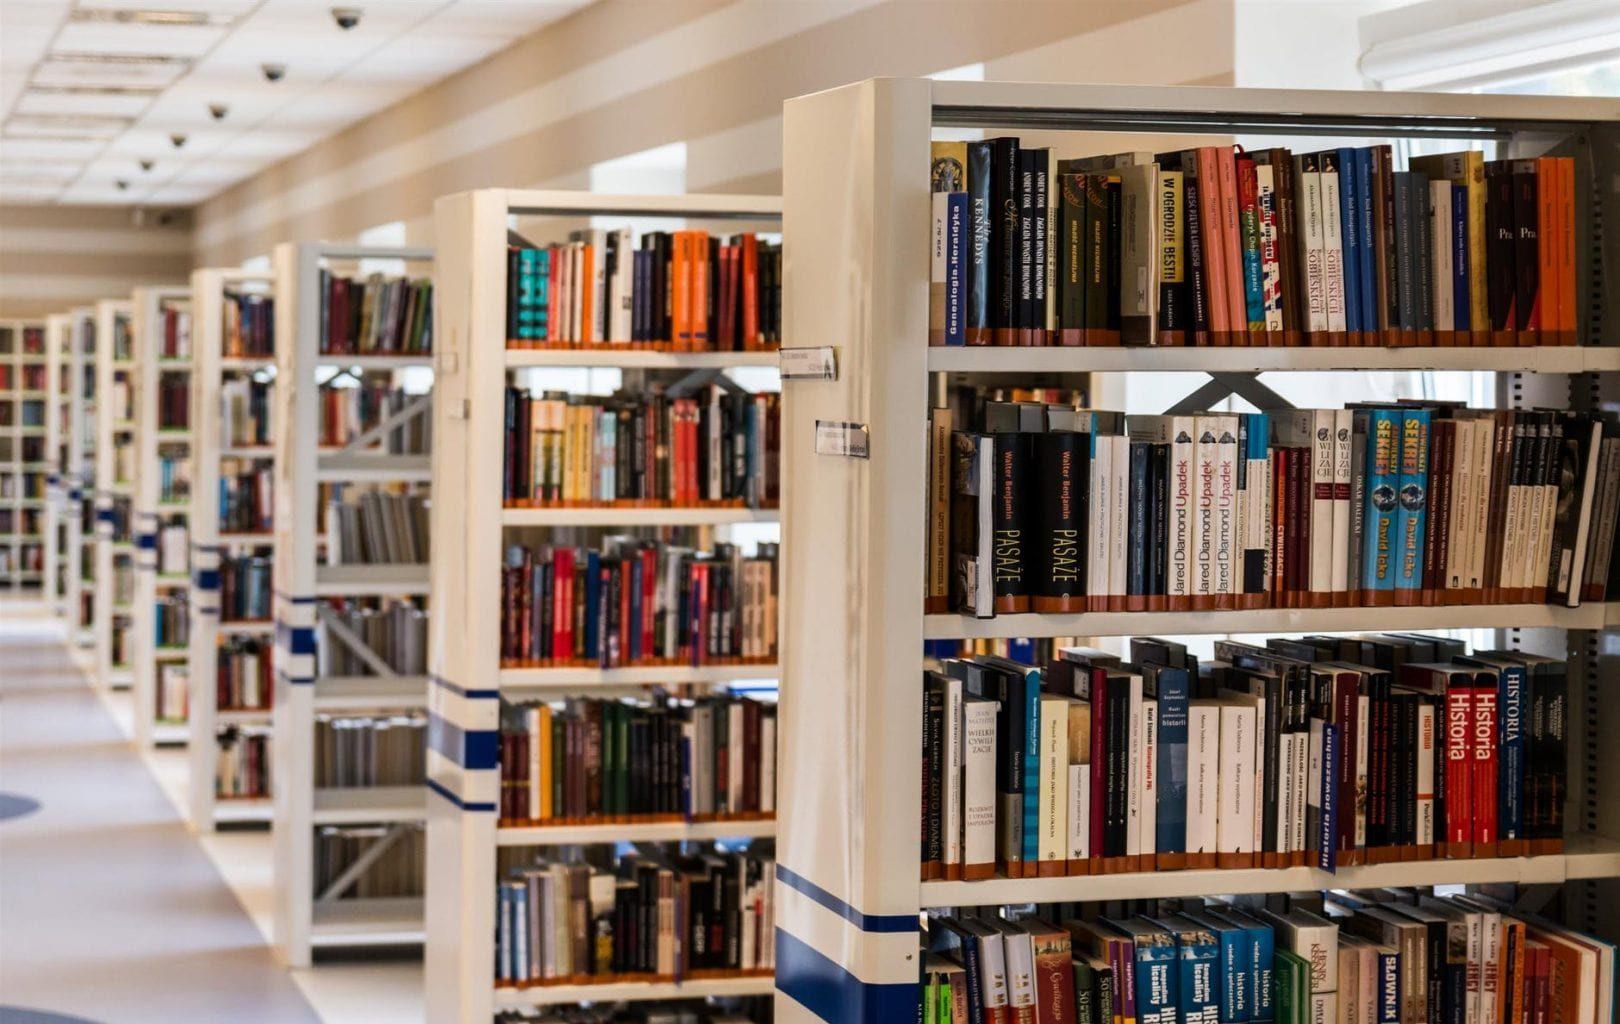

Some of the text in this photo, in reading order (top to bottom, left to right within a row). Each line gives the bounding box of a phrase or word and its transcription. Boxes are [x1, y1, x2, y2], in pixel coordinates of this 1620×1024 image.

[975, 198, 983, 265] KENNEDYS
[1164, 178, 1176, 279] W OGRODZIE BESTII
[1247, 203, 1256, 233] Fryderyk
[1308, 249, 1320, 314] SOBIESKICH
[1328, 249, 1340, 314] SOBIESKICH
[1375, 419, 1392, 475] SEKRET
[1403, 418, 1420, 474] SEKRET
[1003, 451, 1014, 520] Walter Benjamin
[1060, 451, 1071, 520] Walter Benjamin
[996, 529, 1023, 583] PASAŻE
[1053, 529, 1080, 583] PASAŻE
[1175, 460, 1189, 596] Jared Diamond Upadek
[1199, 460, 1213, 596] Jared Diamond Upadek
[1218, 460, 1232, 596] Jared Diamond Upadek
[1376, 516, 1390, 580] David Icke
[1404, 516, 1418, 578] David Icke
[1424, 715, 1432, 750] HISTORIA
[1450, 693, 1469, 760] Historia
[1476, 693, 1496, 760] Historia
[1506, 673, 1520, 742] HISTORIA
[932, 776, 941, 810] ZŁOTO
[1322, 727, 1334, 867] Historia powszechna
[1080, 991, 1090, 1004] 50
[1100, 977, 1109, 990] 50
[1150, 965, 1161, 1005] licealisty
[1193, 963, 1203, 1003] licealisty
[1237, 972, 1246, 1010] historia
[1262, 969, 1271, 1007] historia
